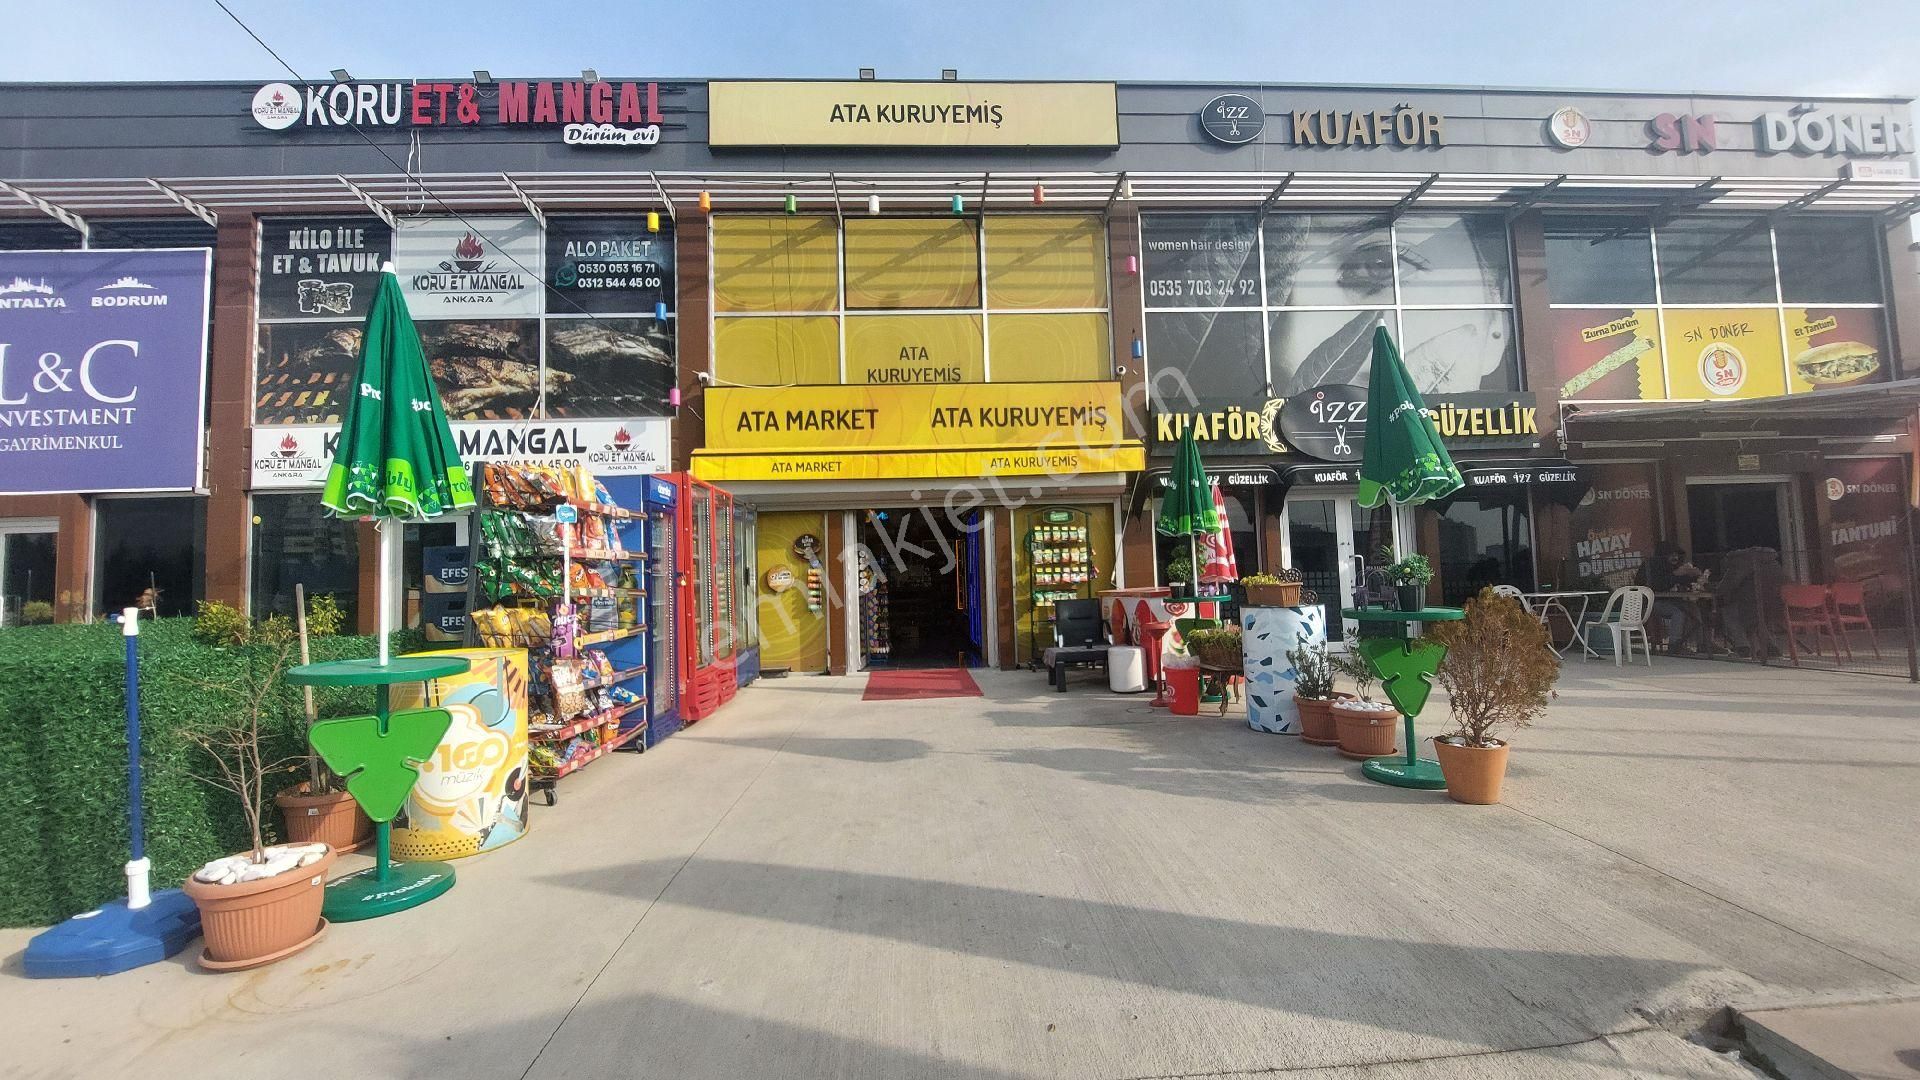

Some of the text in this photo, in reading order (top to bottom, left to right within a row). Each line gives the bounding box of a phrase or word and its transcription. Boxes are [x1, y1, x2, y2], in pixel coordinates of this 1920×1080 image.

[306, 83, 402, 126] KORU
[499, 81, 664, 123] MANGAL
[830, 100, 1003, 129] ATA KURUYEMİŞ
[1292, 103, 1441, 146] KUAFÖR
[1653, 103, 1912, 152] SN DÖNER
[568, 128, 655, 141] Dürüm evi
[289, 226, 365, 250] KİLO İLE
[1149, 239, 1251, 252] women hair design
[564, 240, 651, 257] ALO PAKET
[272, 252, 381, 274] ET & TAVUK
[578, 263, 655, 274] 0530 053 16 71
[412, 273, 525, 291] KORU ET MANGAL
[578, 277, 661, 288] 0312 544 45 00
[1150, 279, 1256, 296] 0535 703 24 92
[0, 295, 168, 309] NTALYA BODRUM
[442, 295, 494, 303] ANKARA
[1584, 319, 1640, 339] Zurna Dürüm
[1683, 326, 1703, 343] SN
[899, 346, 929, 361] ATA
[1715, 368, 1734, 381] SN
[0, 407, 137, 428] NVESTMENT
[736, 409, 879, 433] ATA MARKET
[931, 400, 1107, 432] ATA KURUYEMİŞ
[459, 427, 588, 456] MANGAL
[254, 458, 322, 470] KORU ET MANGAL
[588, 452, 656, 463] KORU ET MANGAL
[990, 453, 1078, 470] ATA KURUYEMİŞ
[771, 460, 843, 473] ATA MARKET
[1228, 473, 1269, 485] GÜZELLİK
[1314, 469, 1348, 483] KUAFÖR
[1473, 472, 1507, 485] KUAFÖR
[1539, 470, 1577, 483] GÜZELLİK
[1597, 487, 1651, 500] SN DÖNER
[1846, 481, 1898, 494] SN DÖNER
[1576, 532, 1633, 558] HATAY
[441, 567, 469, 579] EFES
